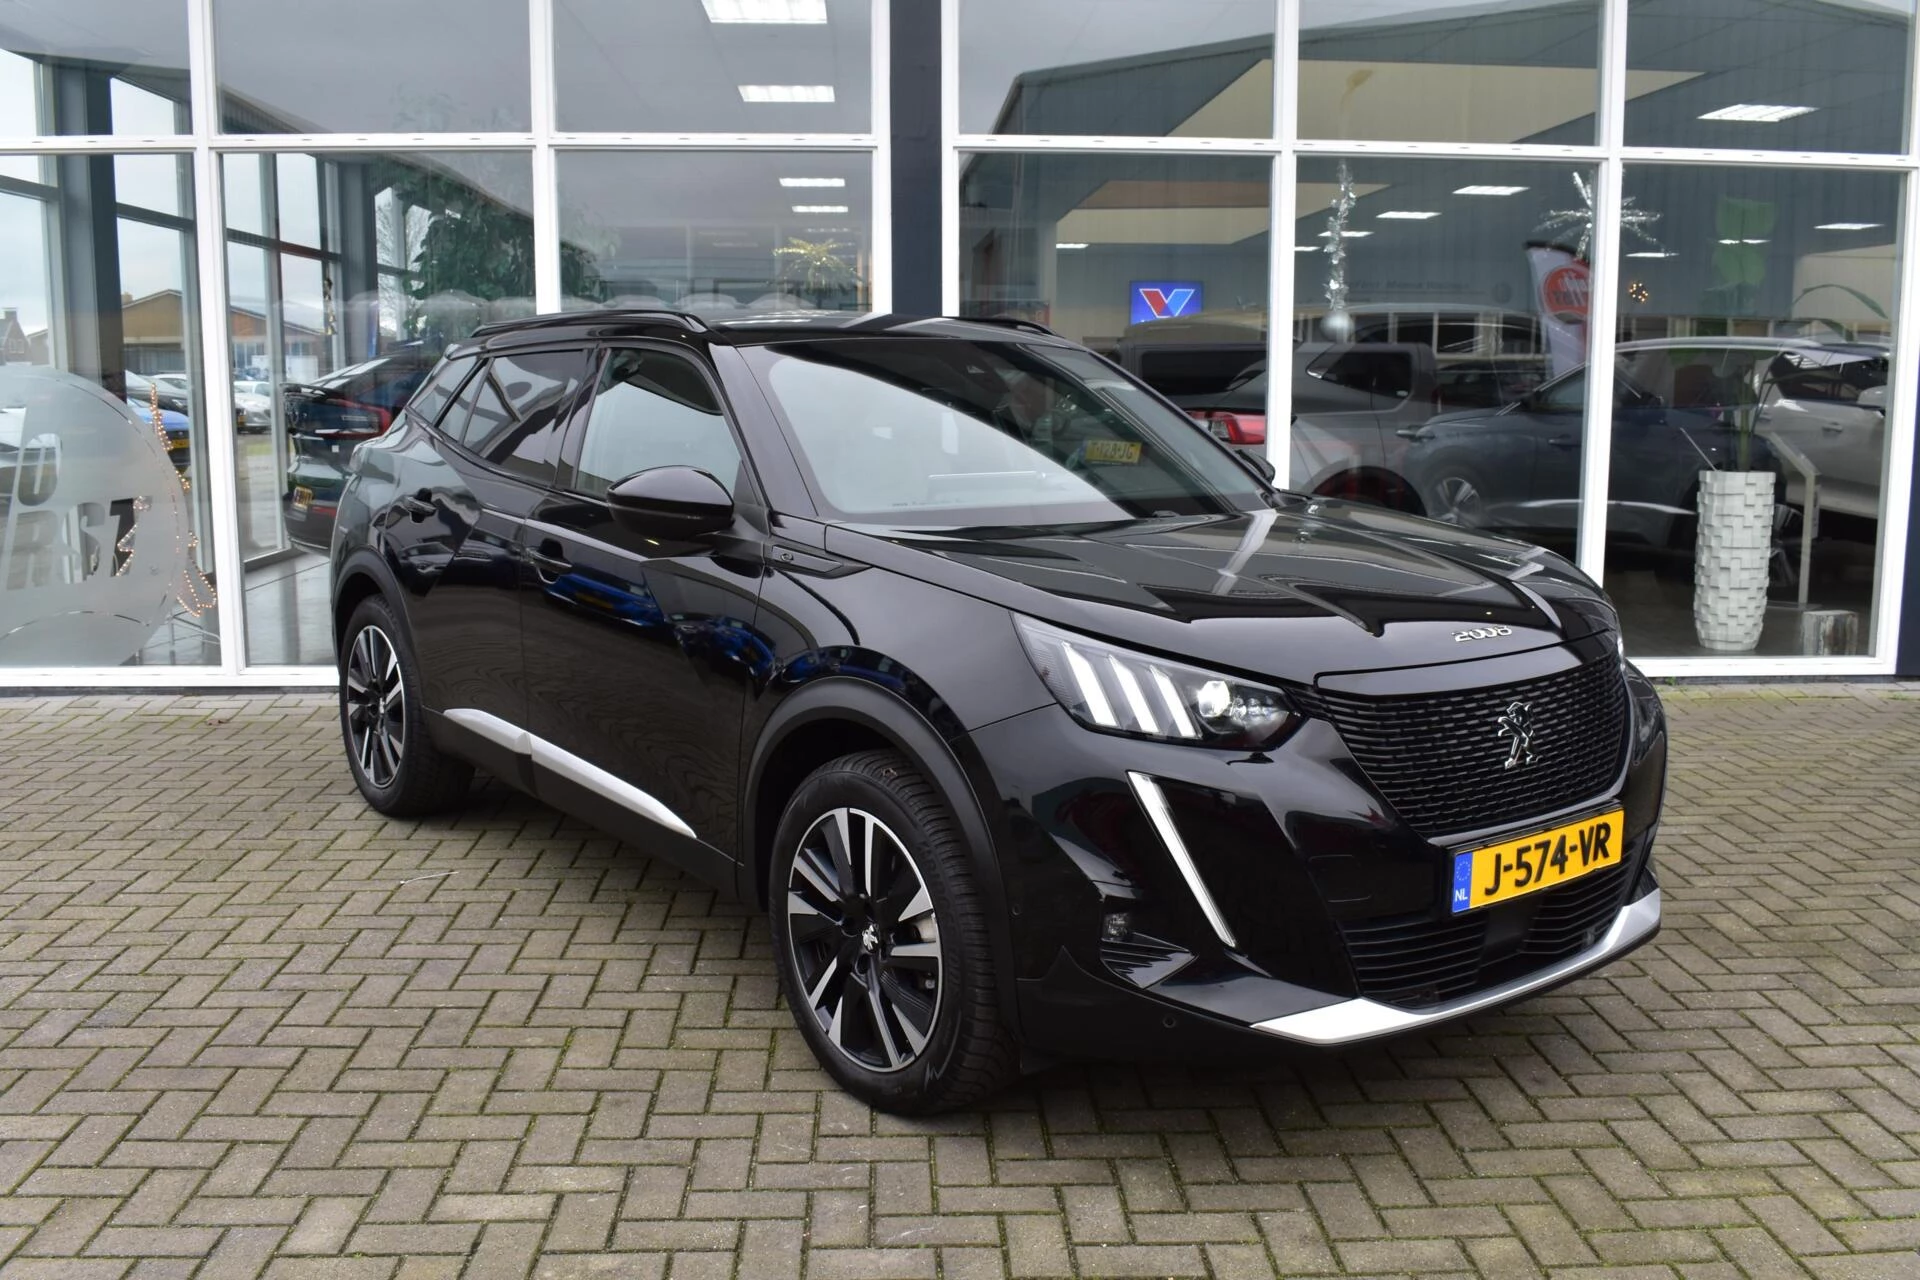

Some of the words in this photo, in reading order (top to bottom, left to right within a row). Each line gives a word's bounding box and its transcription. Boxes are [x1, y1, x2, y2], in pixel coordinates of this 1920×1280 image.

[1451, 625, 1513, 642] 2008
[1484, 821, 1611, 897] J-574-VR
[1454, 888, 1469, 901] NL
